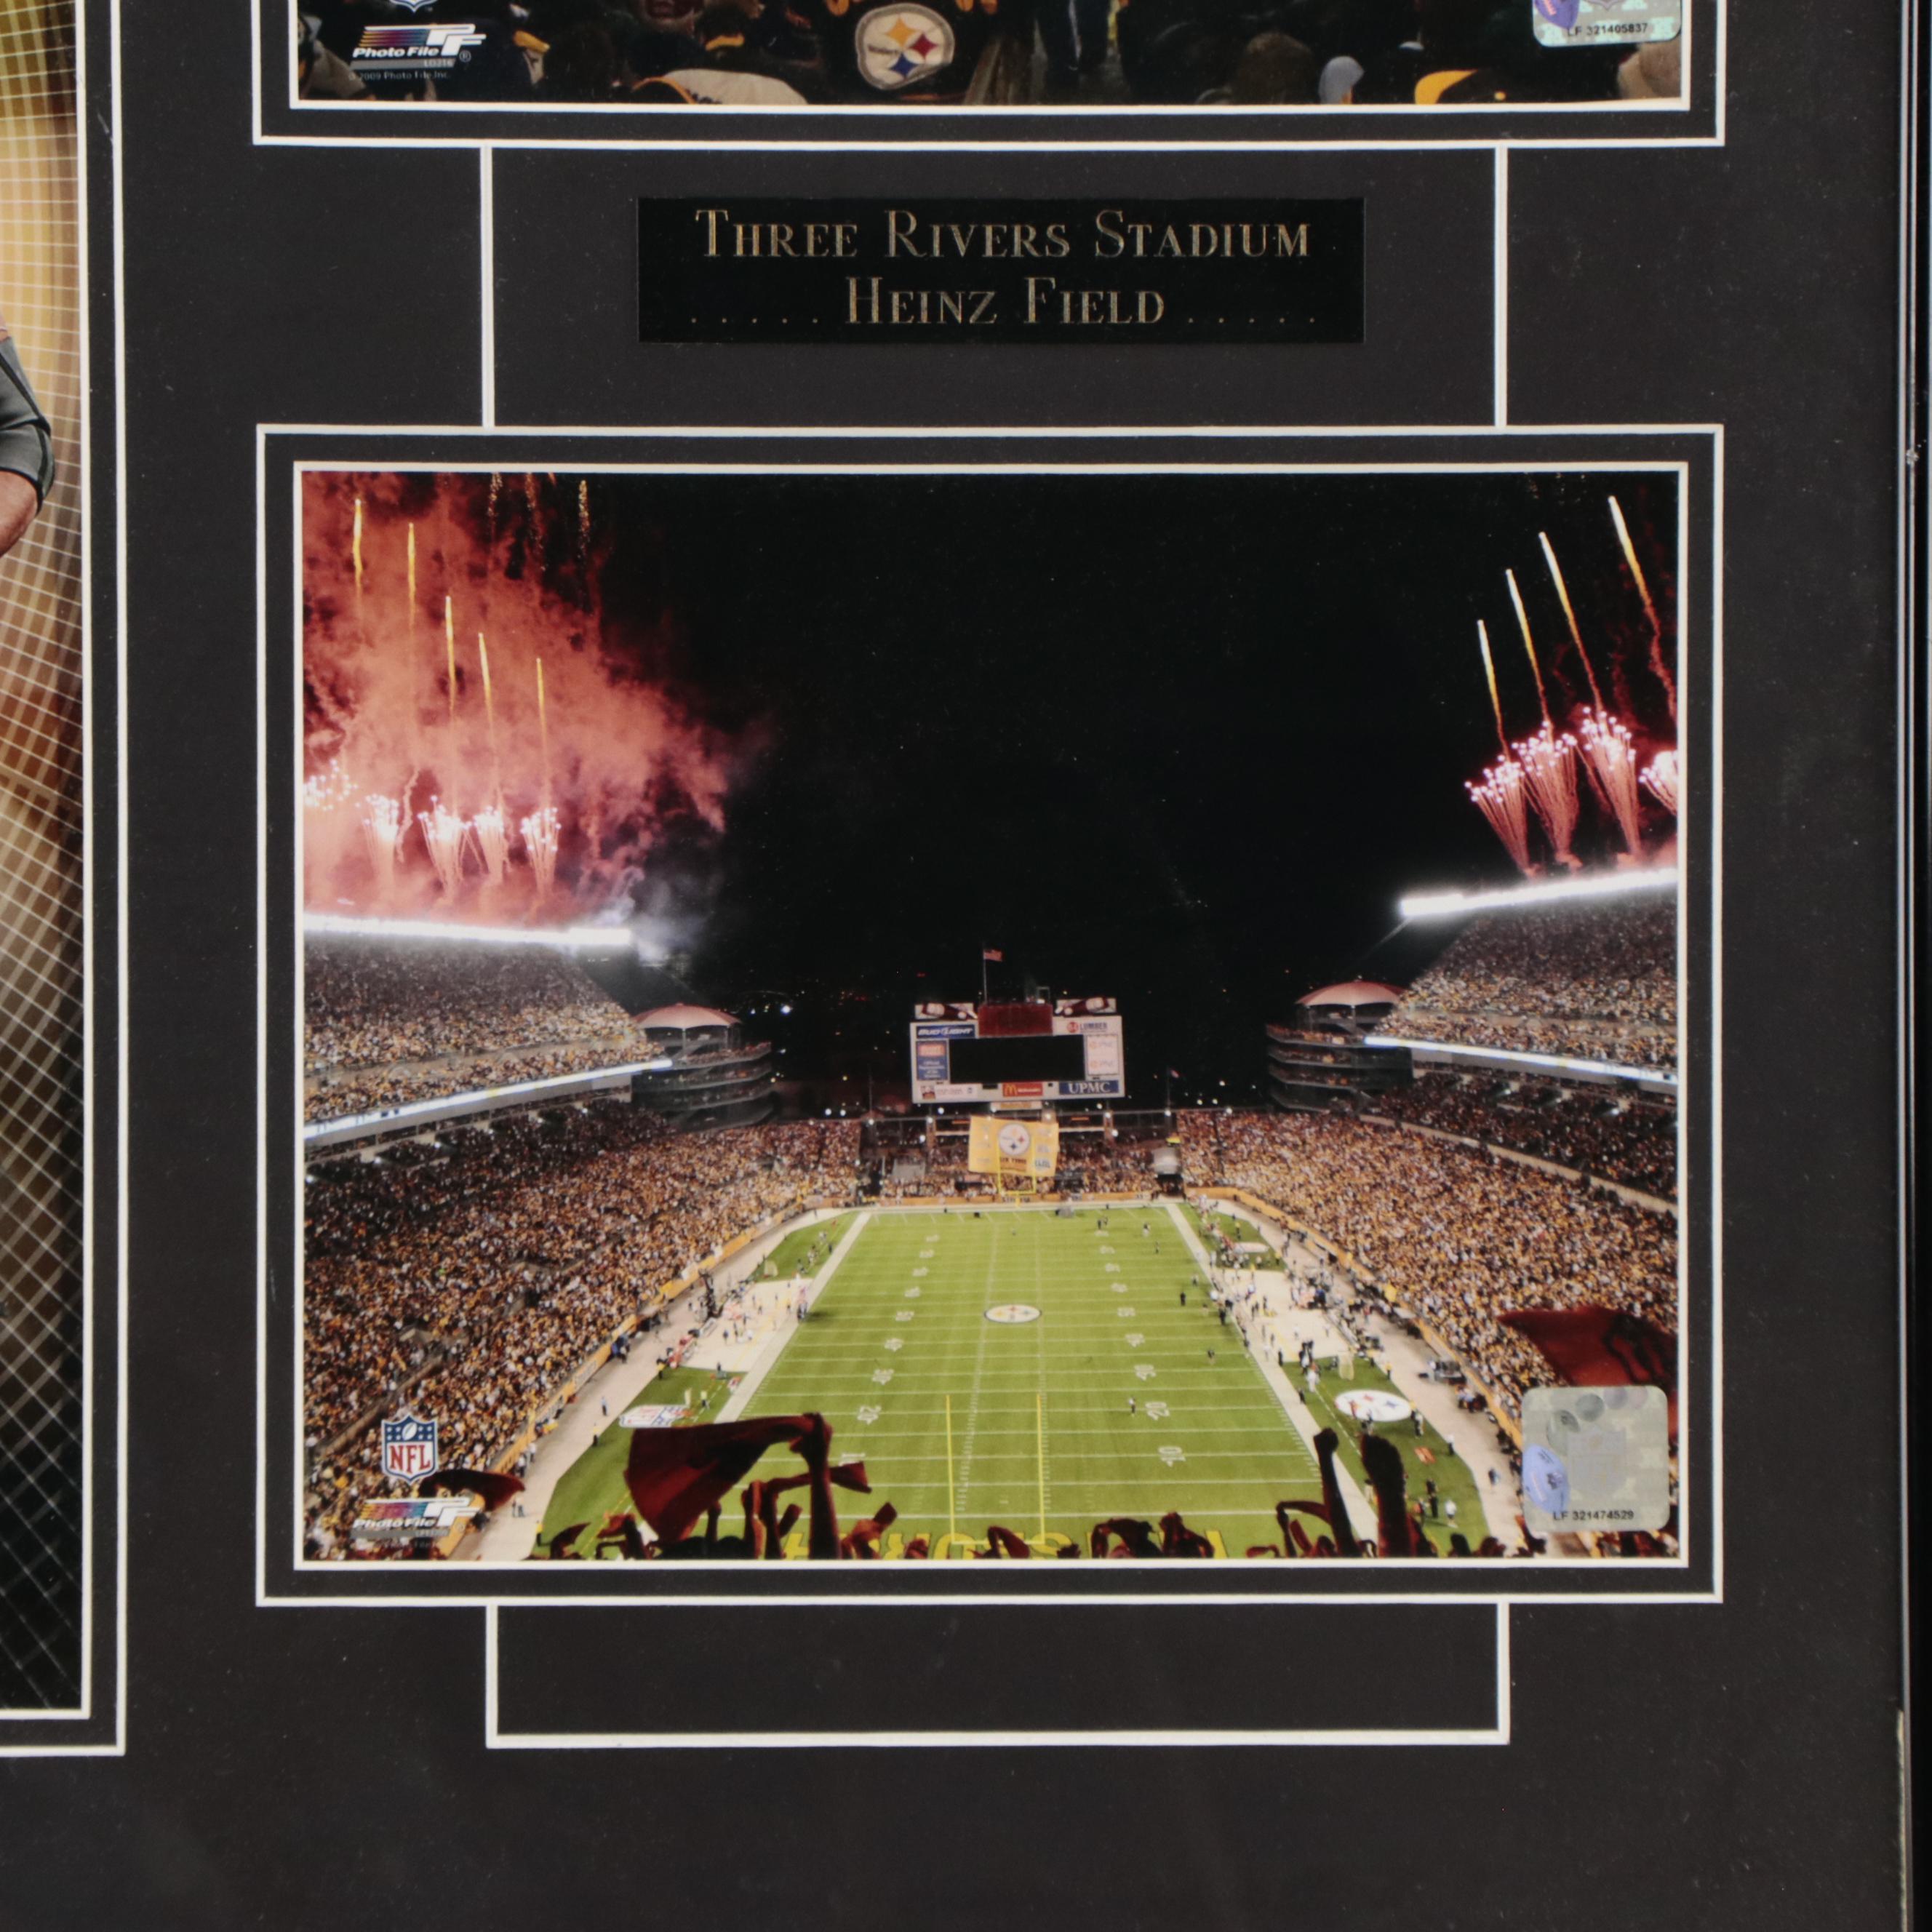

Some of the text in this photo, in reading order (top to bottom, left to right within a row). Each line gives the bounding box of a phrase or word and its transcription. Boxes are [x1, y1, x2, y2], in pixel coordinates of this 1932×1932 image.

[1567, 23, 1648, 36] LF 321405837
[352, 47, 439, 58] Photo File
[695, 209, 1309, 258] THREE RIVERS STADIUM
[846, 276, 1165, 324] HEINZ FIELD
[1068, 1082, 1111, 1094] UPMC
[389, 1445, 431, 1473] NFL
[1553, 1510, 1634, 1520] LF 321474529
[353, 1518, 436, 1528] Photo File
